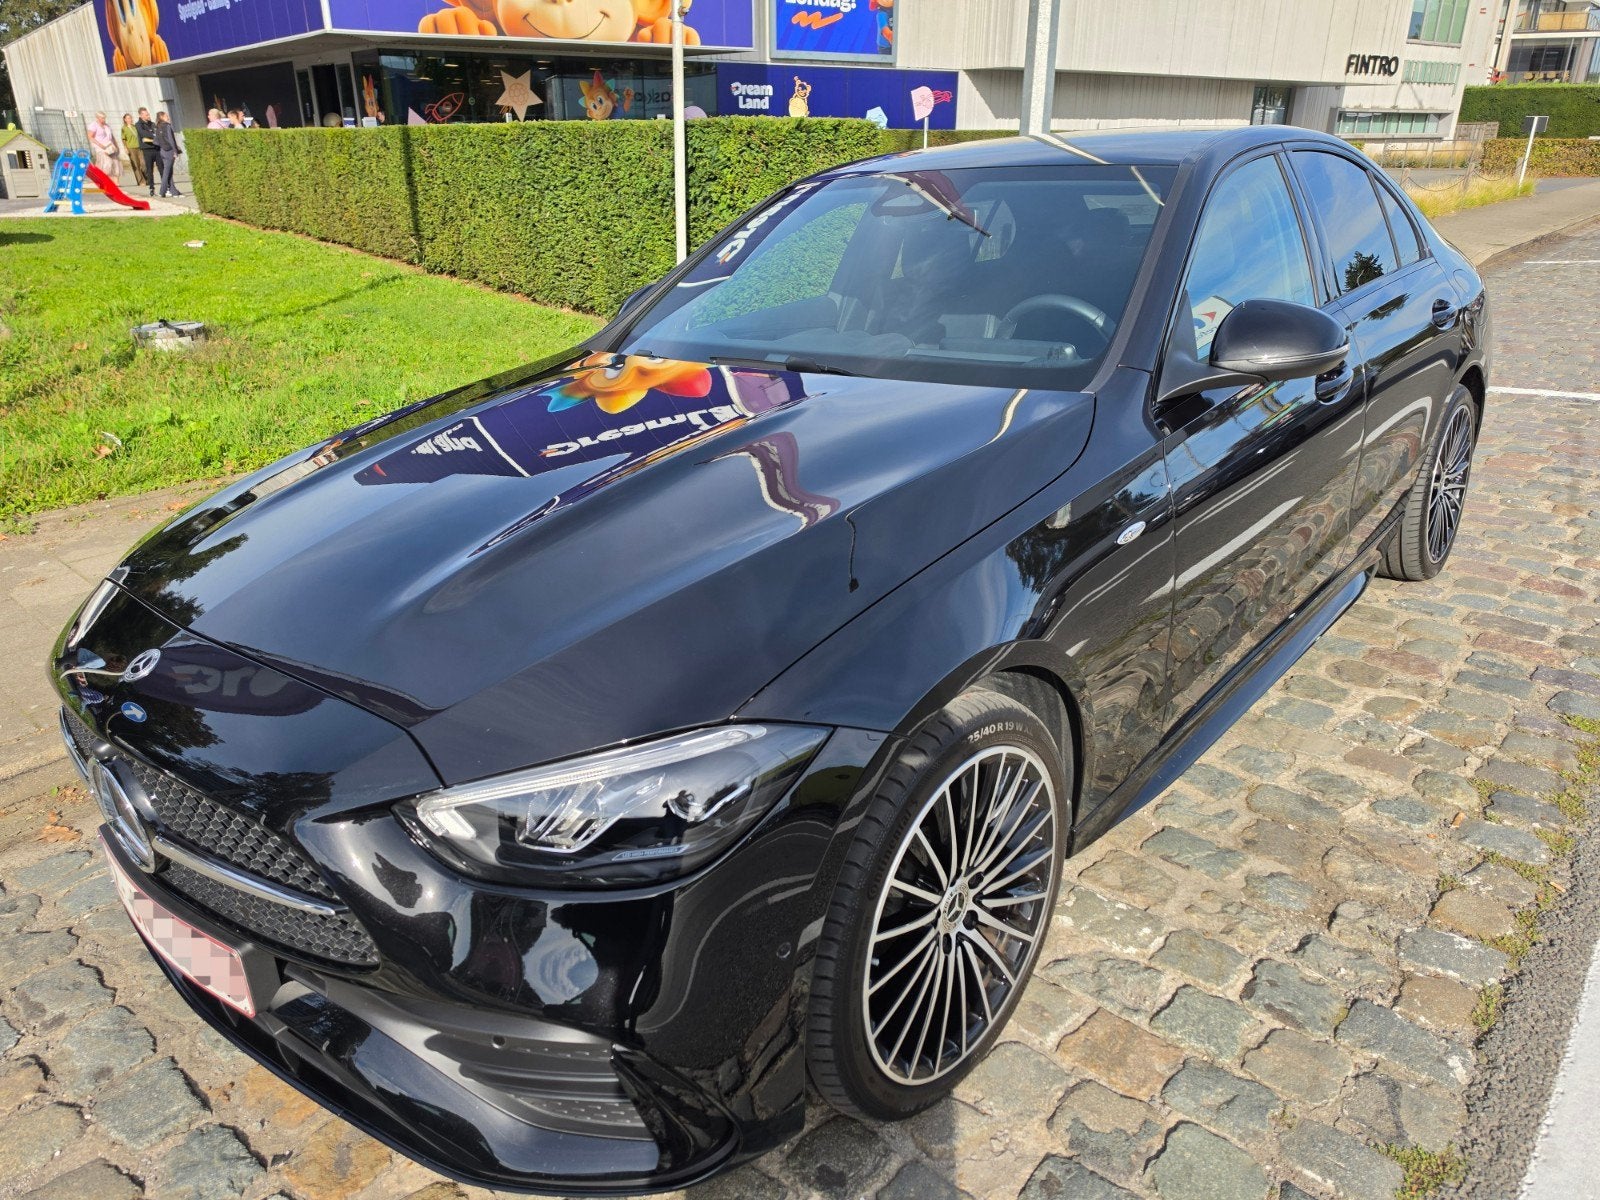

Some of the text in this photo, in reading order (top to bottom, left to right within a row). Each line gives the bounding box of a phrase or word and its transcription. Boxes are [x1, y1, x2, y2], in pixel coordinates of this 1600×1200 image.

[1344, 53, 1399, 77] FINTRO
[730, 81, 774, 96] Dream
[738, 95, 770, 110] Land
[997, 721, 1004, 732] R
[1005, 720, 1015, 731] 19
